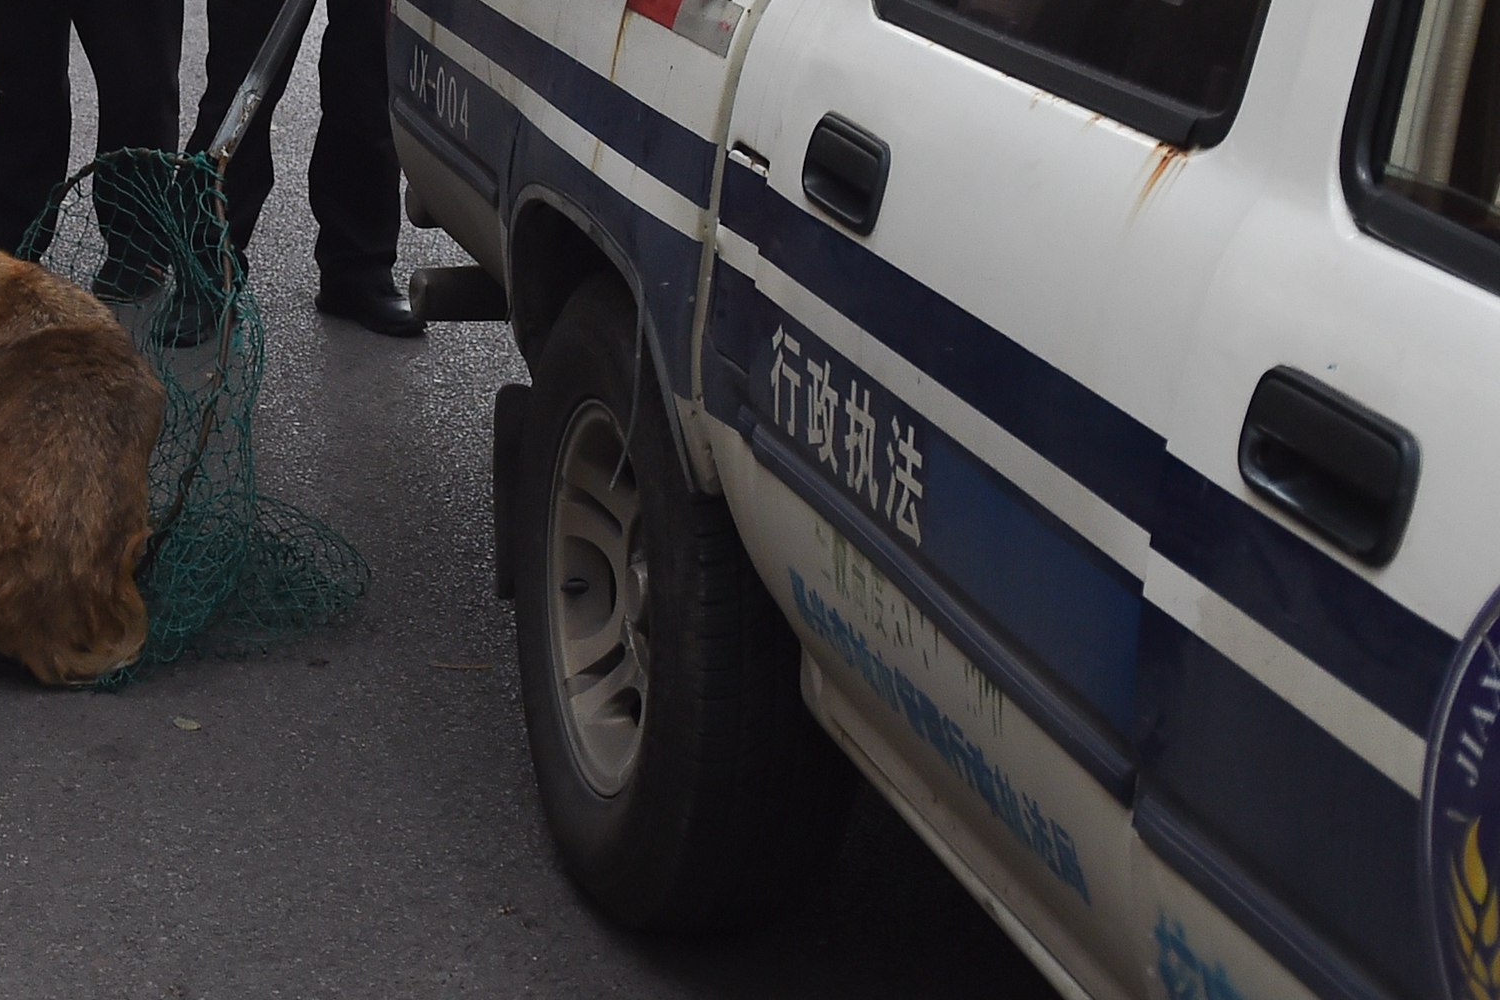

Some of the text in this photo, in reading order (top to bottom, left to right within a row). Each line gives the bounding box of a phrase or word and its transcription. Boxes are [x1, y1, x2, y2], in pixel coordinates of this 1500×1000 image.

[409, 44, 468, 140] JX-004
[770, 323, 923, 548] 行政执法
